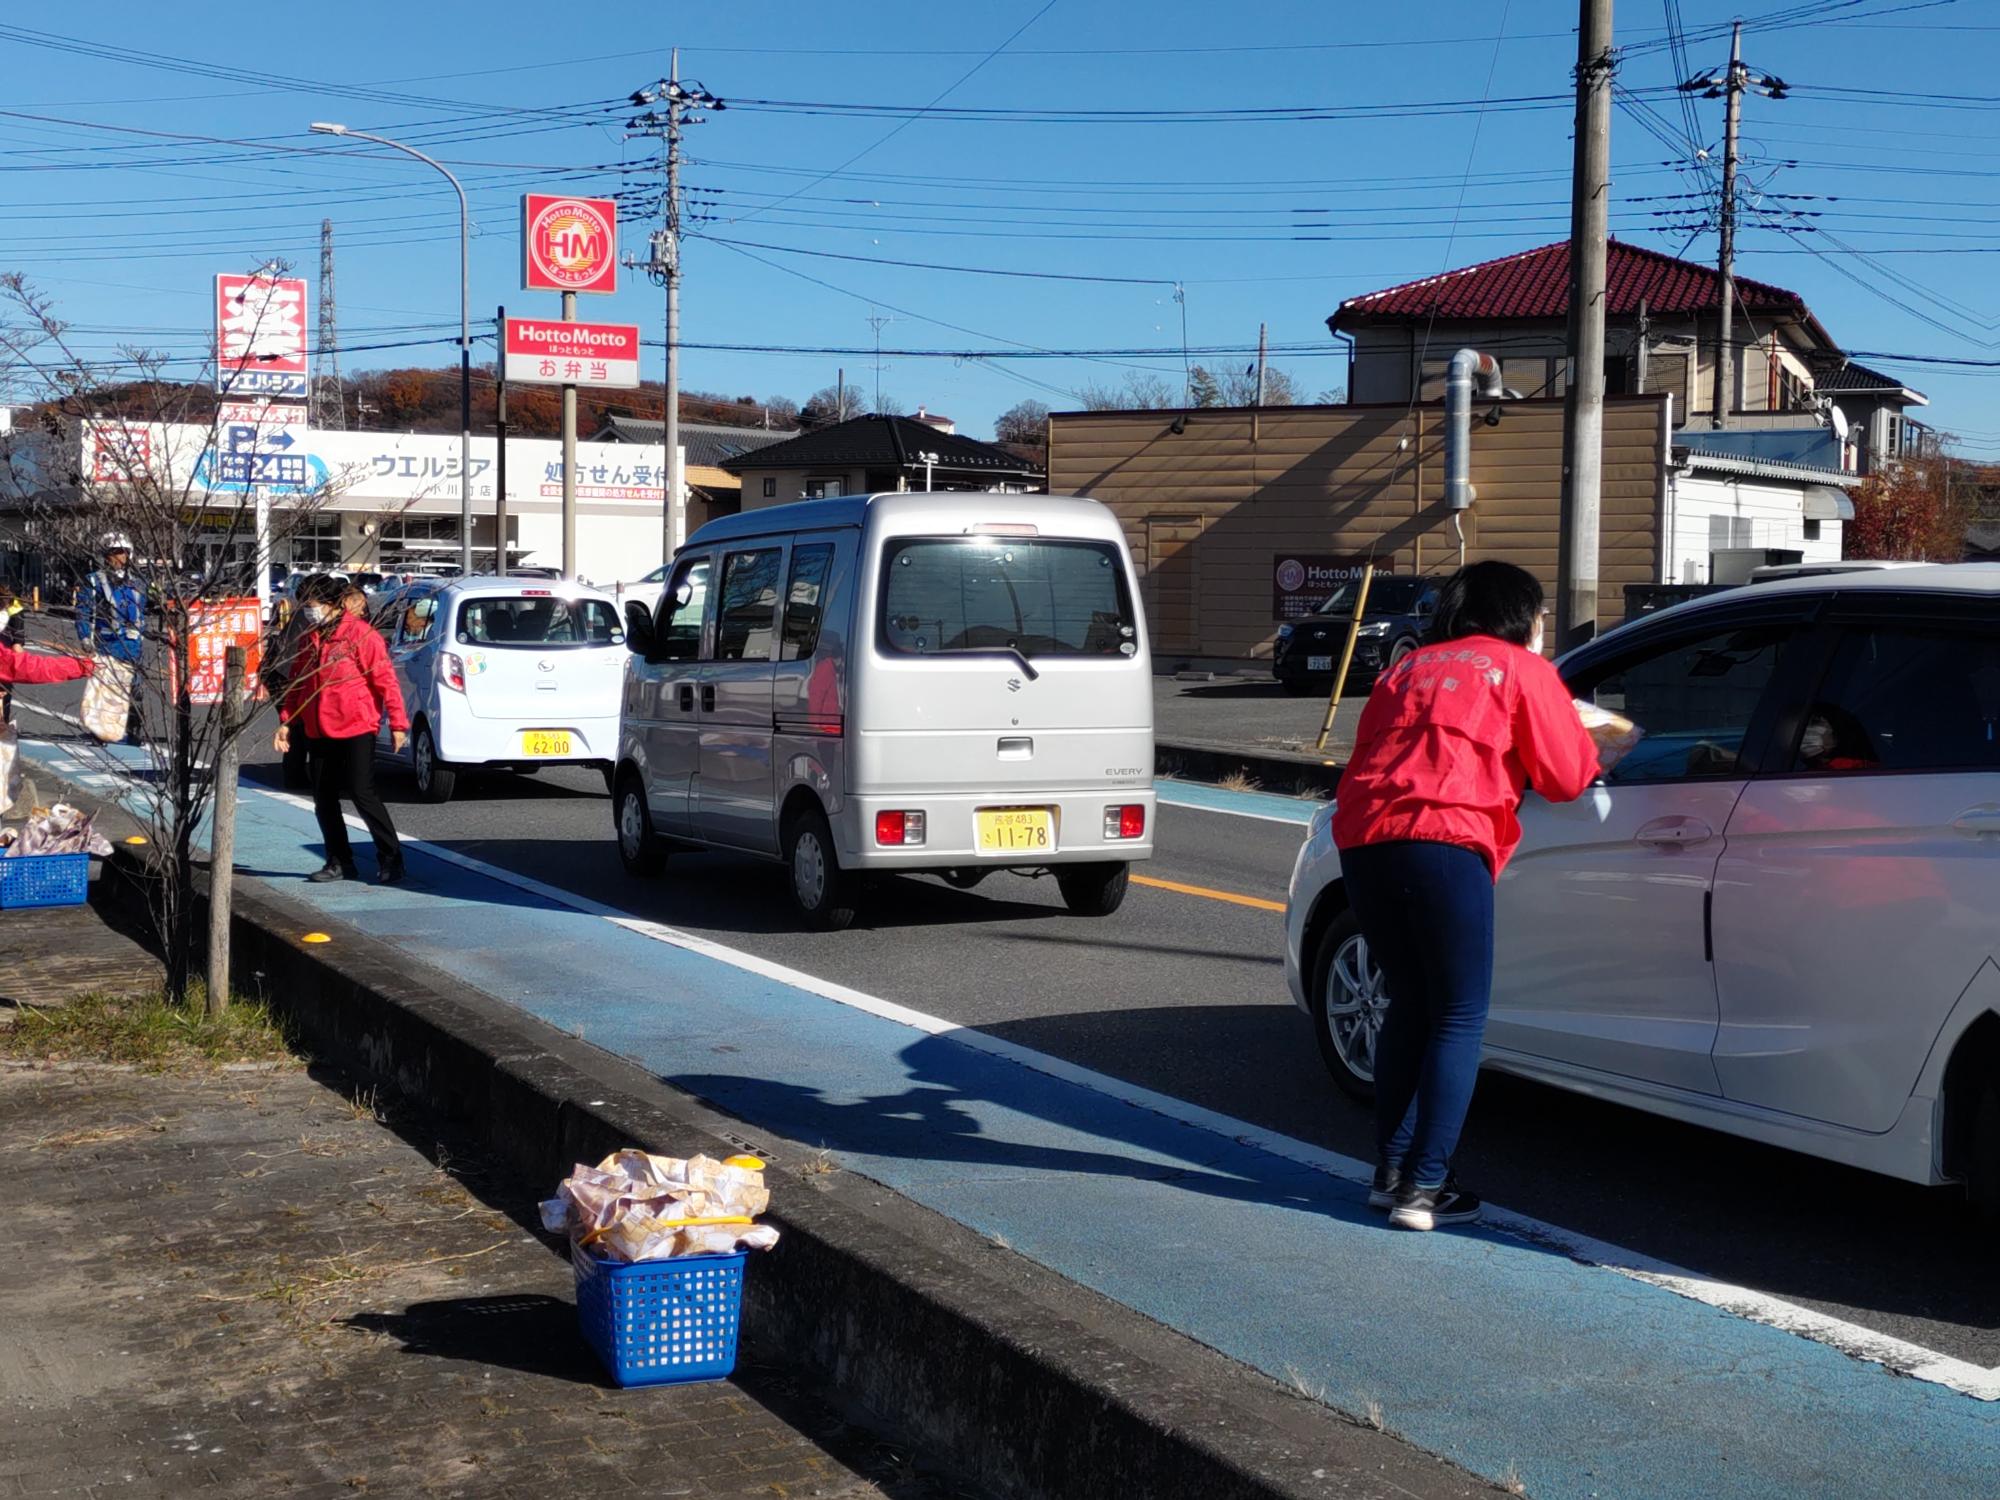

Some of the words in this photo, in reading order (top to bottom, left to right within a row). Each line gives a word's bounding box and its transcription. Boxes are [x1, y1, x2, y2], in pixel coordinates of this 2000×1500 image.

[549, 263, 596, 281] ほっともっと
[549, 345, 595, 356] ほっともっと
[539, 360, 607, 380] お弁当
[221, 373, 305, 391] ウエルシア
[228, 426, 257, 453] P
[251, 457, 279, 480] 24
[372, 454, 491, 479] ウエルシア
[1104, 767, 1144, 776] EVERY
